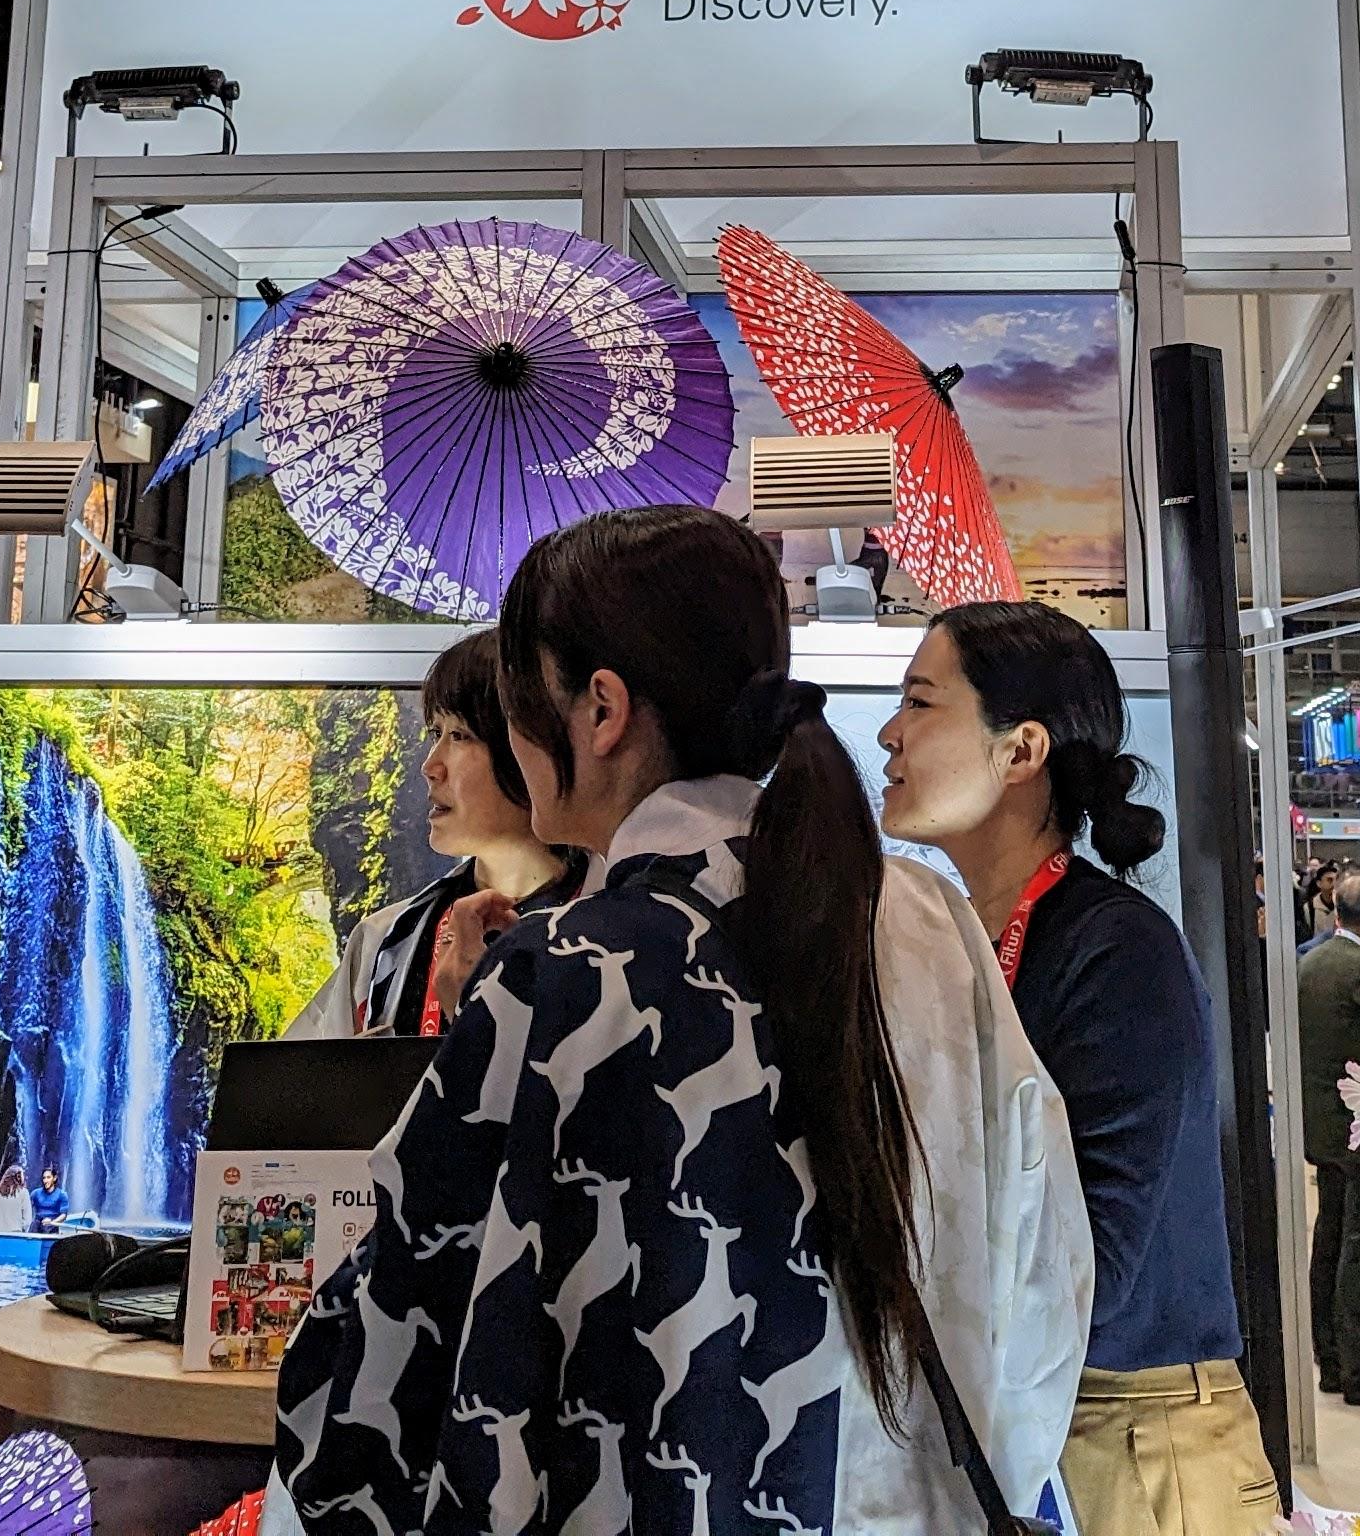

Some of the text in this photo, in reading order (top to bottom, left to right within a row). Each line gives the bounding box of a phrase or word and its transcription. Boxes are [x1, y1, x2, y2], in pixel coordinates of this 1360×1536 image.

[1160, 495, 1195, 507] BOSE
[1000, 927, 1021, 966] Fitur
[332, 1190, 377, 1207] FOLL
